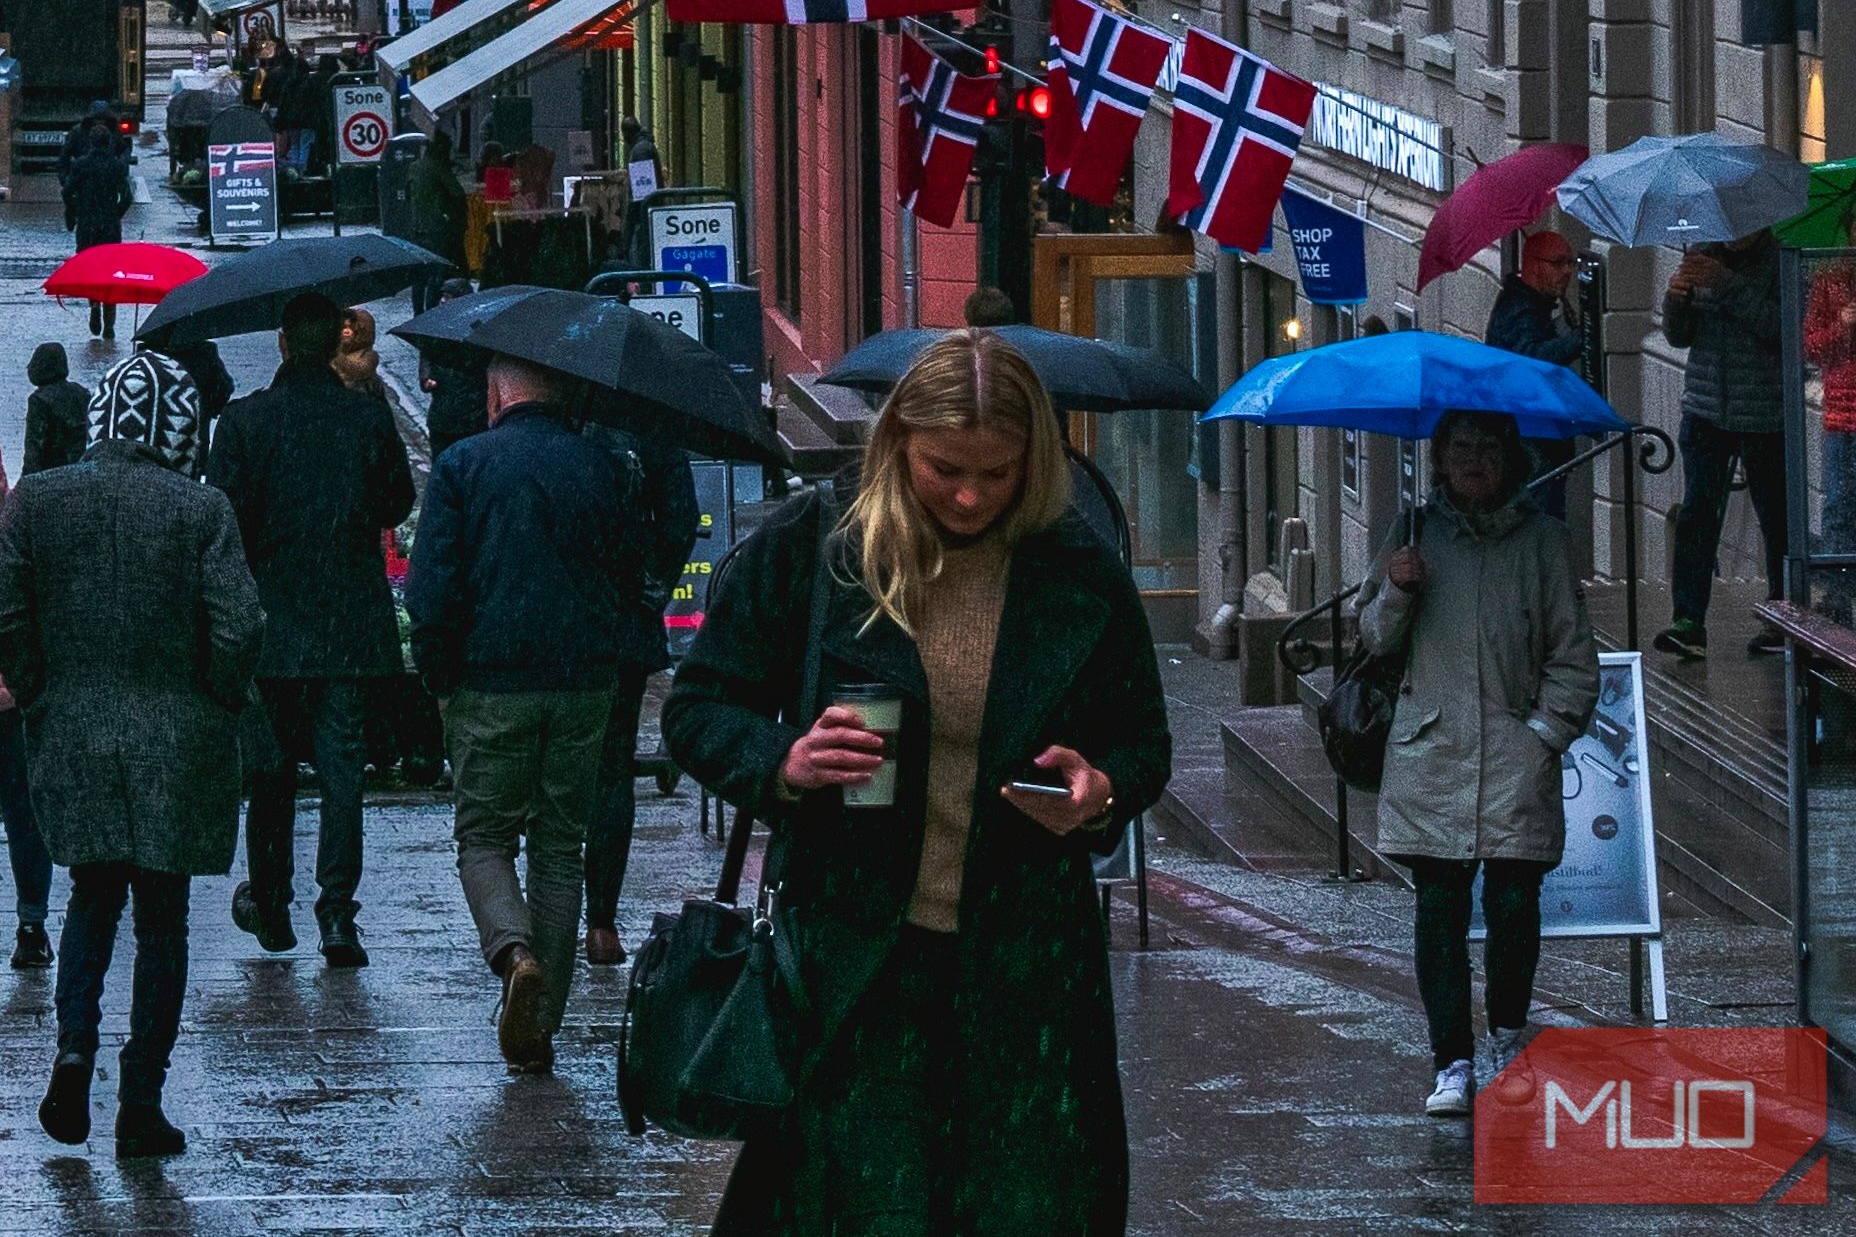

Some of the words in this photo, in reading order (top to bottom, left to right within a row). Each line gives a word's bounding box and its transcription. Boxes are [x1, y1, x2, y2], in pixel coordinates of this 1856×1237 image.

[344, 90, 385, 105] Sone
[351, 123, 381, 146] 30
[226, 178, 253, 188] GIFTS
[254, 178, 263, 187] &
[216, 187, 270, 199] SOUVENIRS
[665, 216, 721, 236] Sone
[1292, 228, 1333, 244] SHOP
[1297, 245, 1321, 261] TAX
[1301, 262, 1331, 278] FREE
